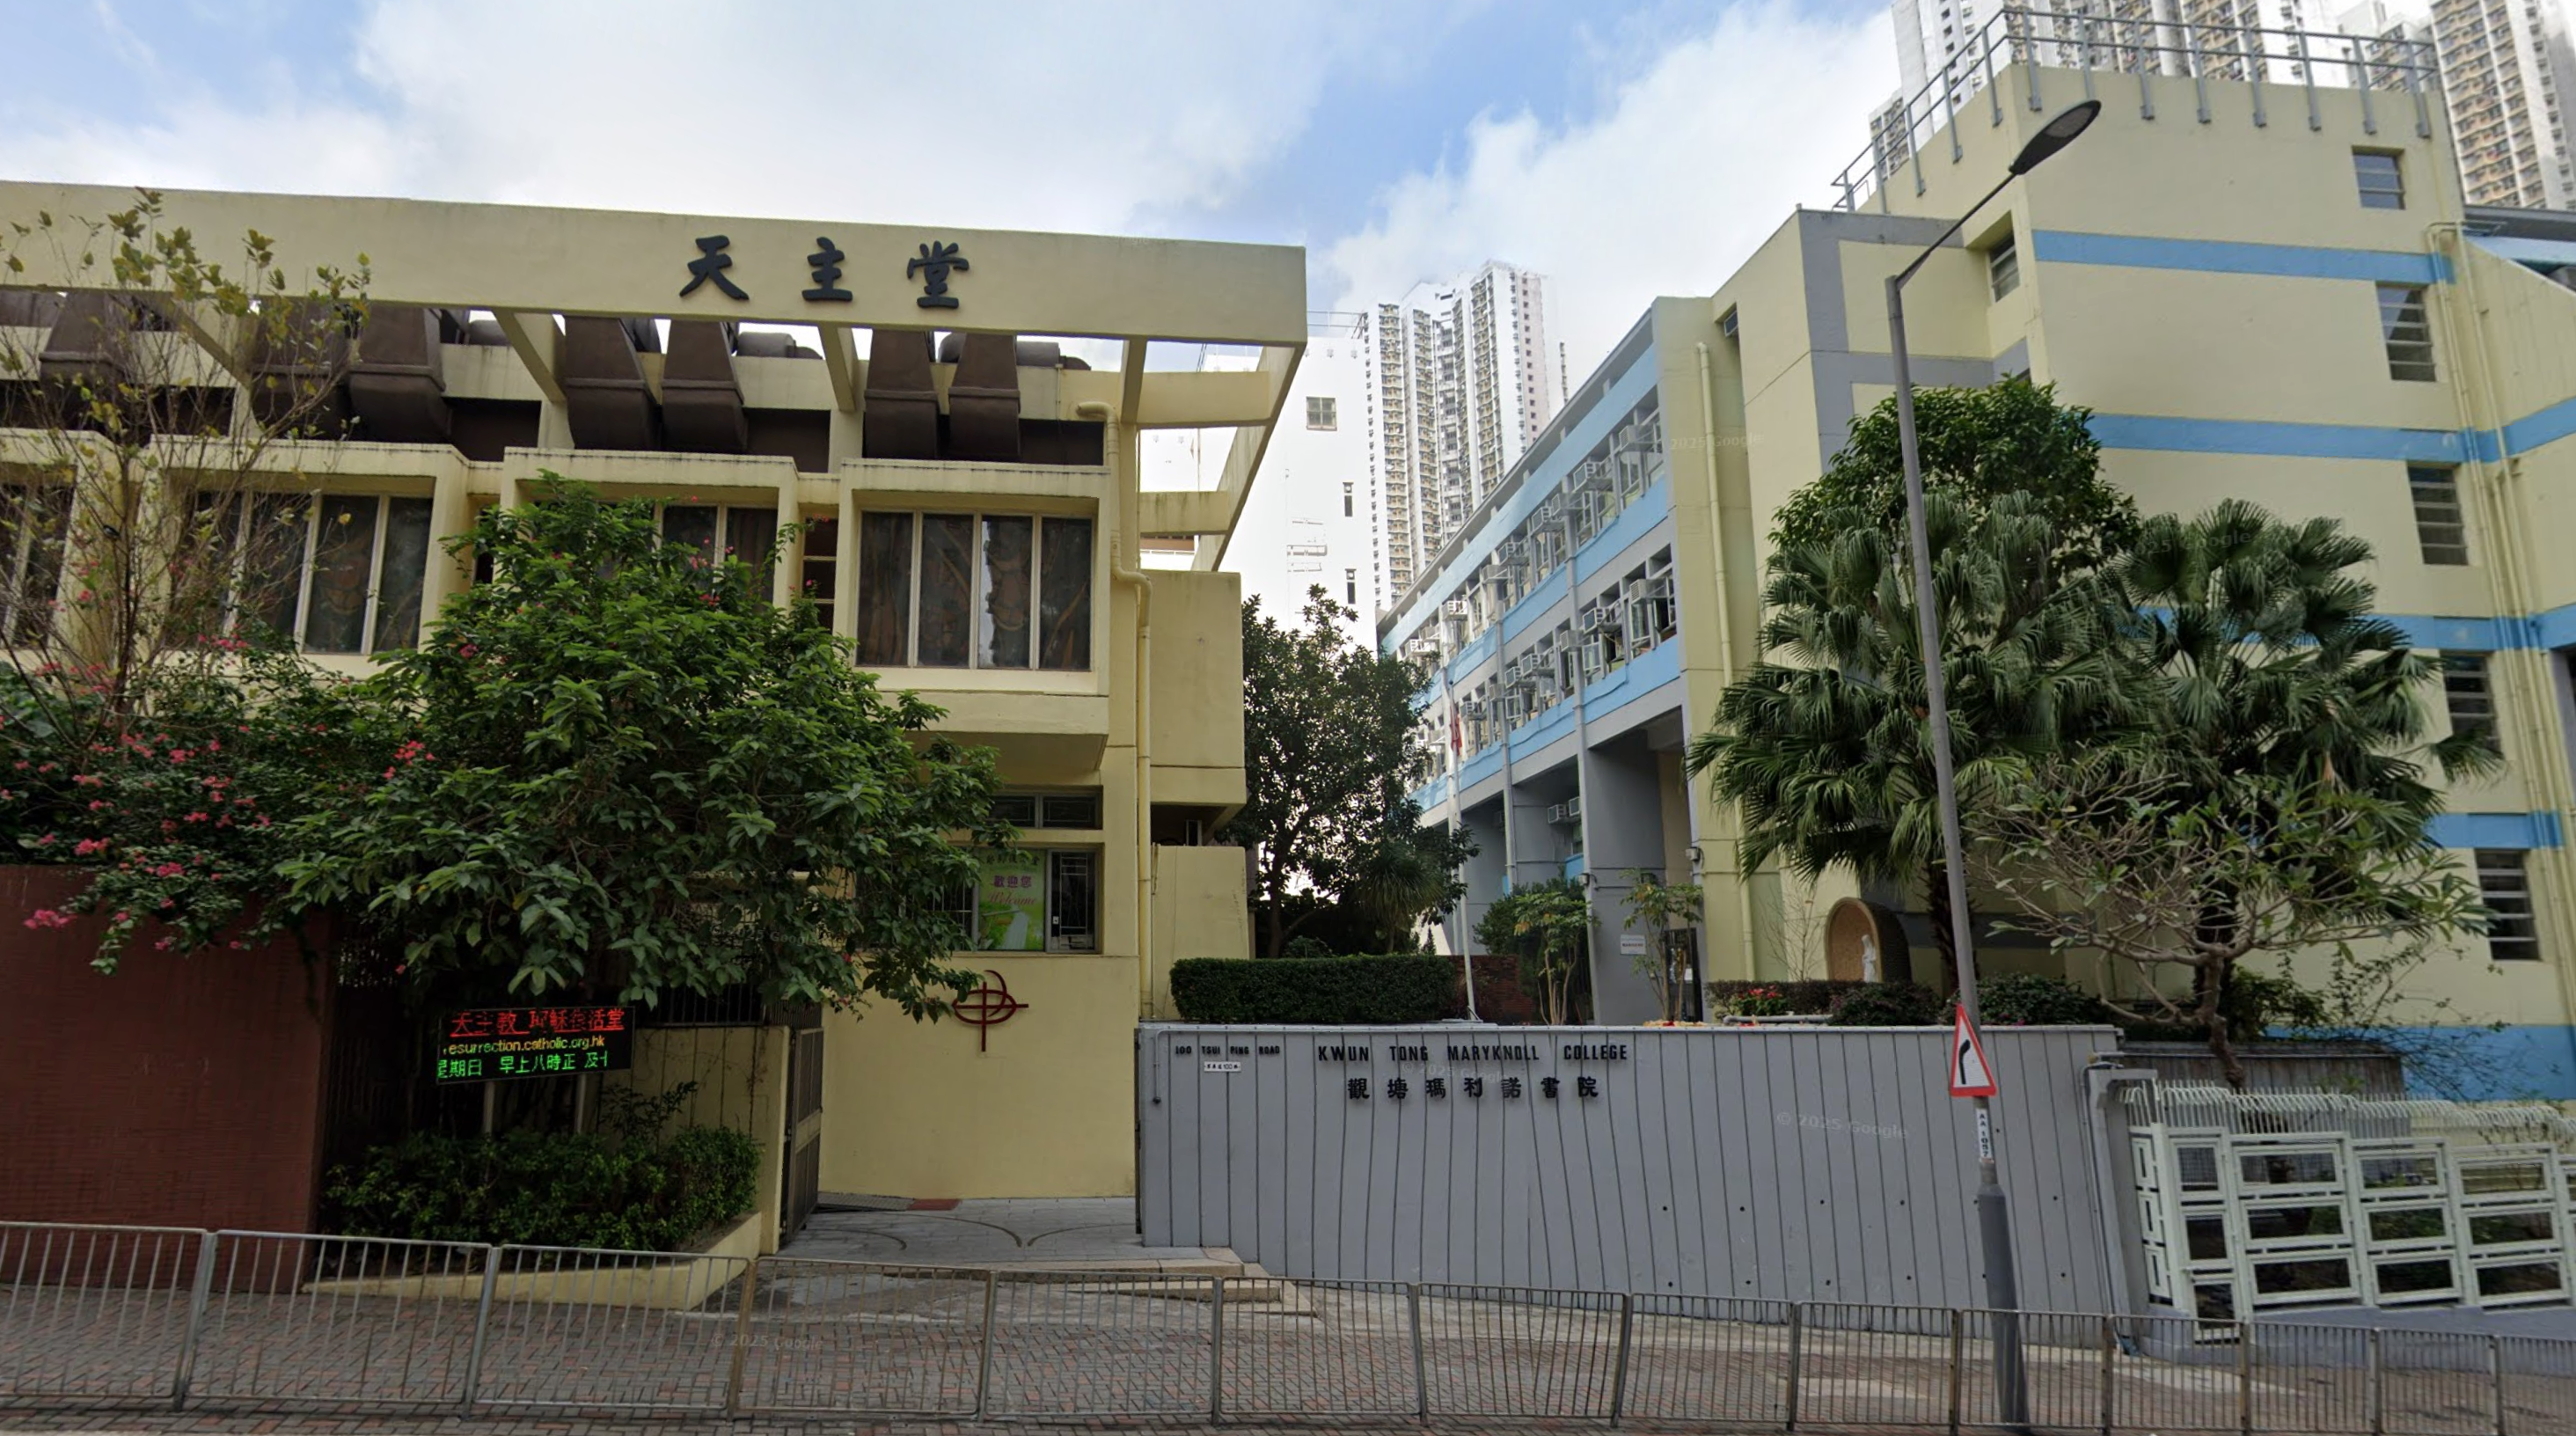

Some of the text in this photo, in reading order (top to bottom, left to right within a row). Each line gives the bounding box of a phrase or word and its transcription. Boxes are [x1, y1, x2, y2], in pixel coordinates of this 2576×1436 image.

[678, 234, 970, 309] 天主堂
[988, 891, 1036, 905] Welcome
[1175, 1045, 1280, 1055] 100 TSUI PING ROAD
[1319, 1044, 1627, 1061] KWUN TONG MARYKNOLL COLLEGE
[499, 1052, 577, 1073] 早上八時正
[1347, 1076, 1599, 1099] 觀塘瑪利諾書院
